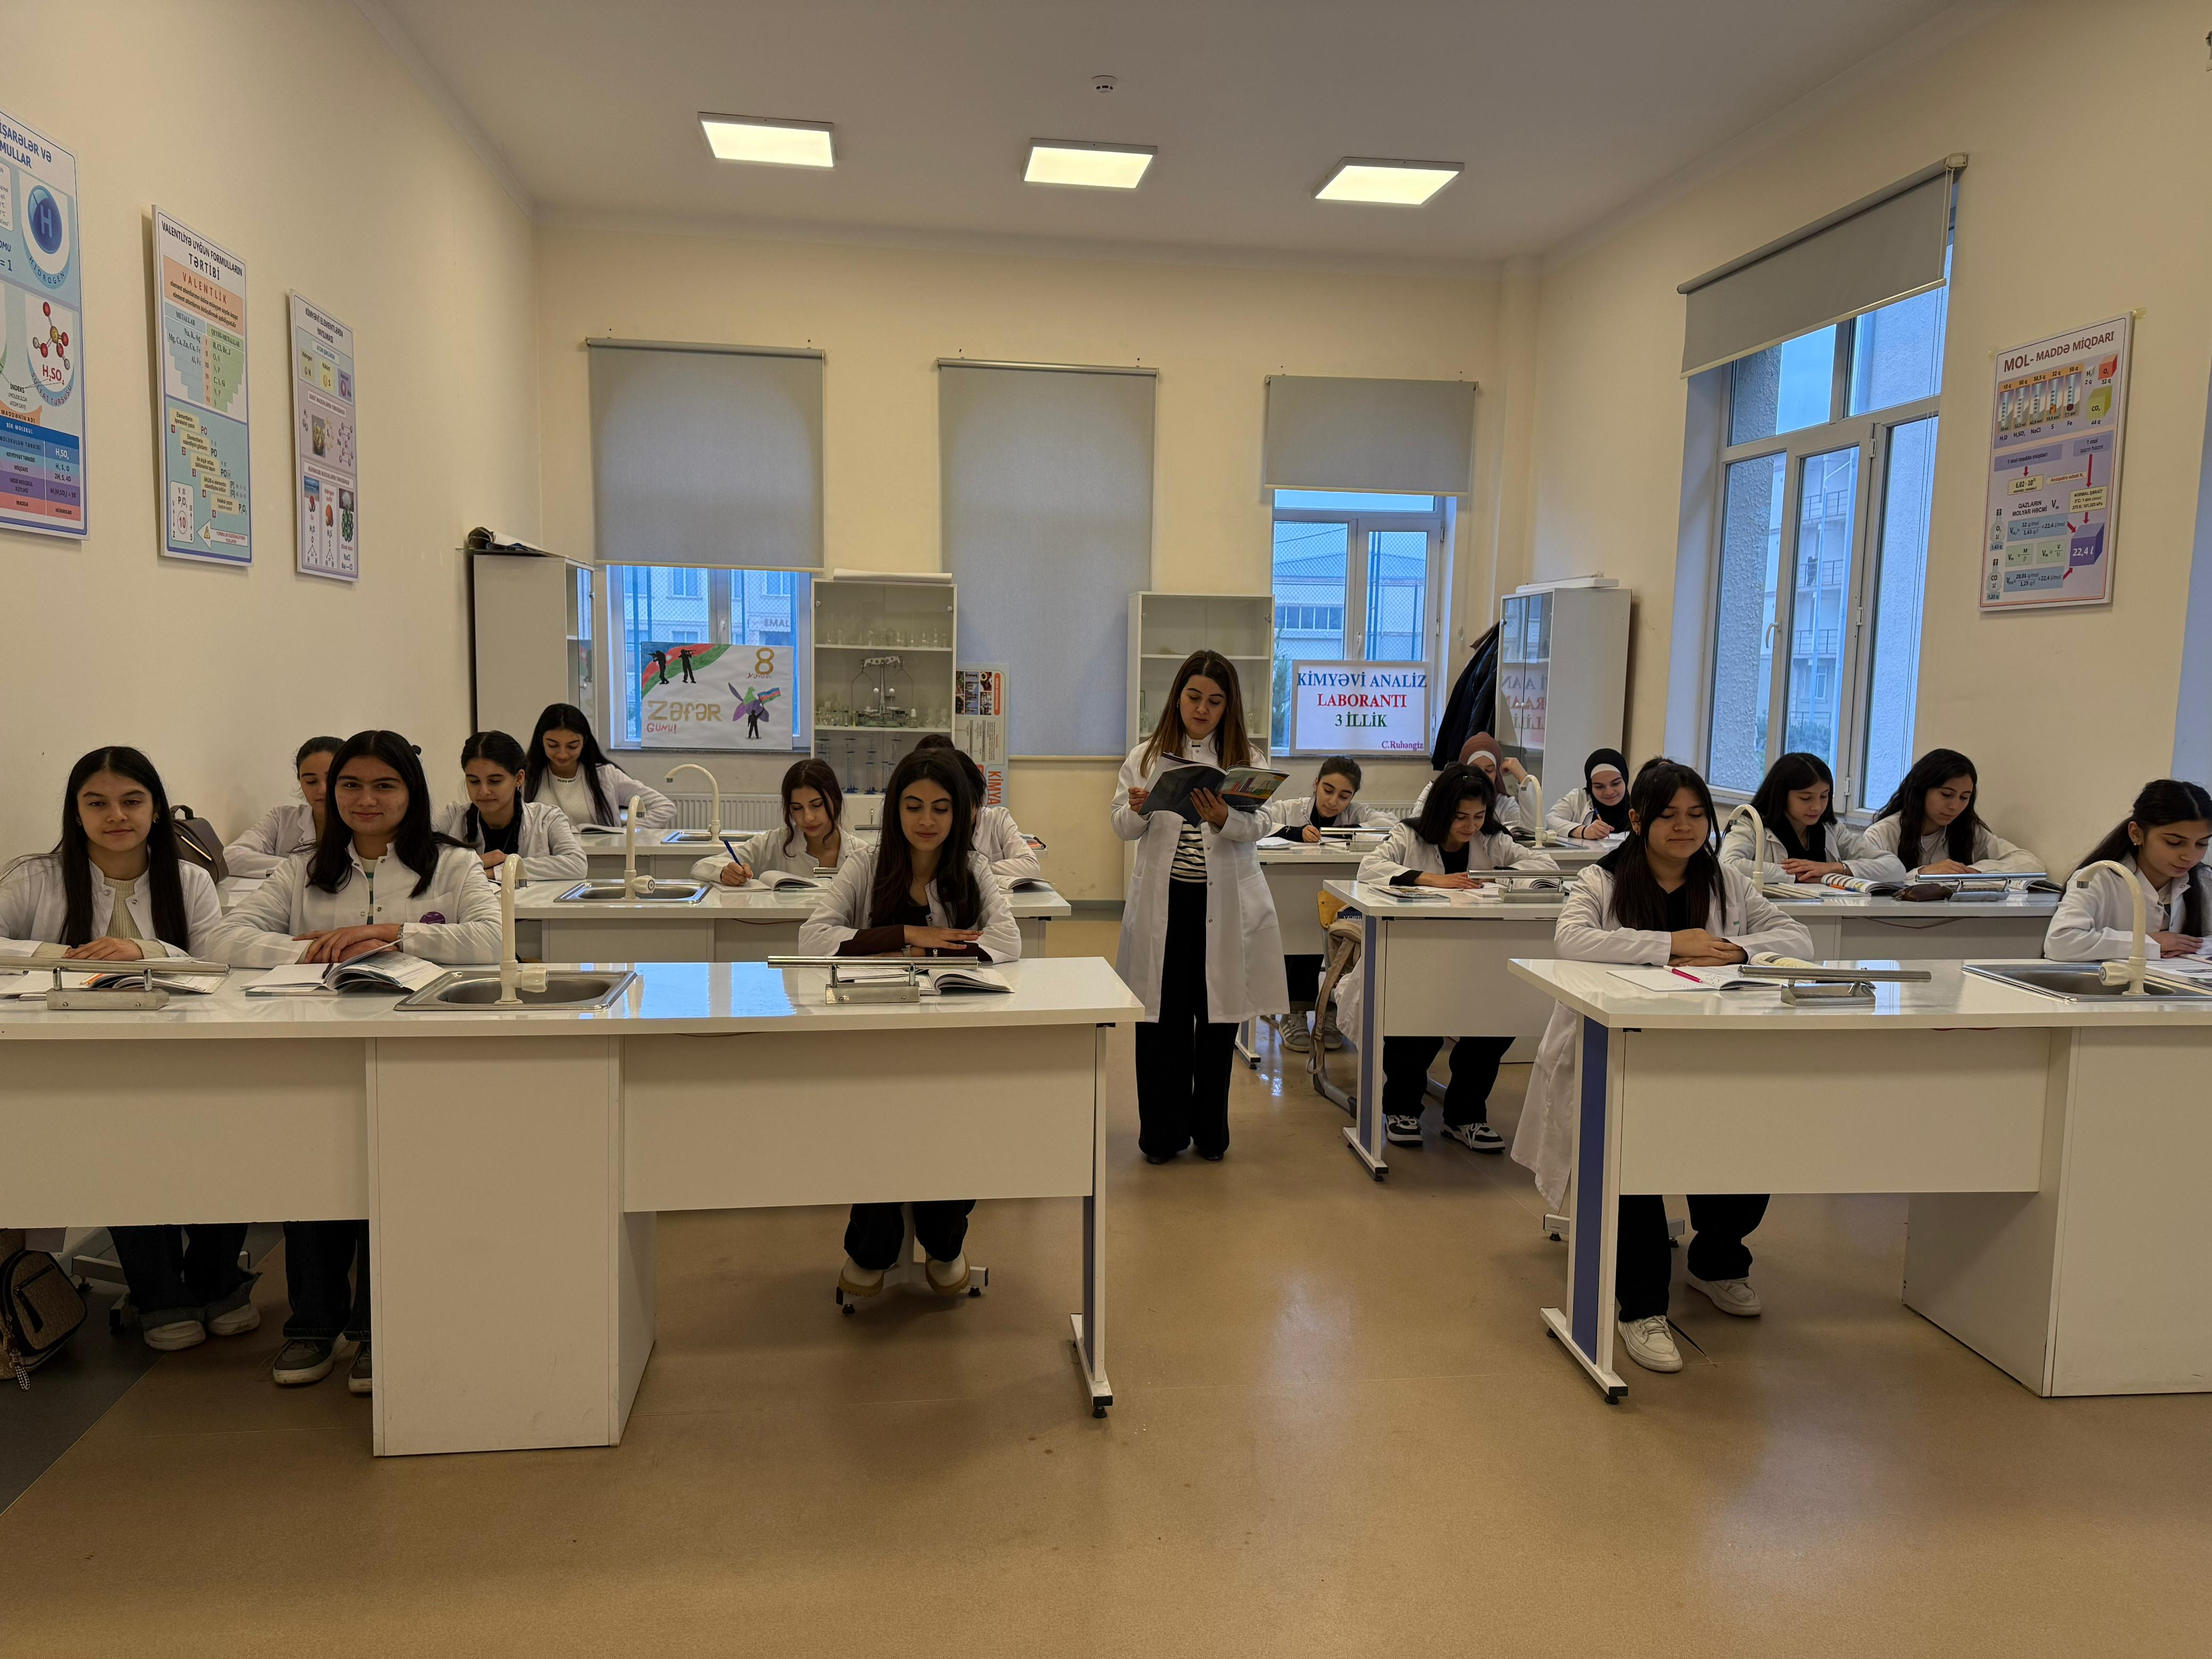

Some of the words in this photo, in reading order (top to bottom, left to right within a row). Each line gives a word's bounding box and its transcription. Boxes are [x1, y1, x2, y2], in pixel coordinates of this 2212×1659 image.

[40, 147, 52, 163] VƏ
[40, 204, 52, 238] H
[162, 221, 192, 246] VALENTLİYƏ
[193, 241, 210, 258] UYĞUN
[211, 250, 242, 277] FORMULLARIN
[189, 253, 220, 281] TƏRTİBİ
[182, 272, 227, 304] VALENTLİK
[176, 311, 196, 326] METALLAR
[2035, 345, 2070, 362] MADDƏ
[2072, 331, 2115, 351] MİQDARI
[10, 382, 25, 393] İNDEKS
[1, 409, 27, 421] MADDƏNİN
[15, 424, 33, 434] MOLEKUL
[2018, 500, 2042, 509] QAZLARIN
[2032, 505, 2048, 514] HƏCMİ
[179, 517, 186, 528] 10
[2073, 547, 2089, 557] 22,4
[754, 647, 775, 675] 8
[1297, 670, 1366, 686] KİMYƏVİ
[1369, 672, 1427, 688] ANALİZ
[1317, 693, 1407, 708] LABORANTI
[1335, 714, 1343, 726] 3
[1345, 711, 1388, 727] İLLİK
[1381, 740, 1424, 751] C.Ruhəngiz
[988, 770, 1004, 806] KİMYA
